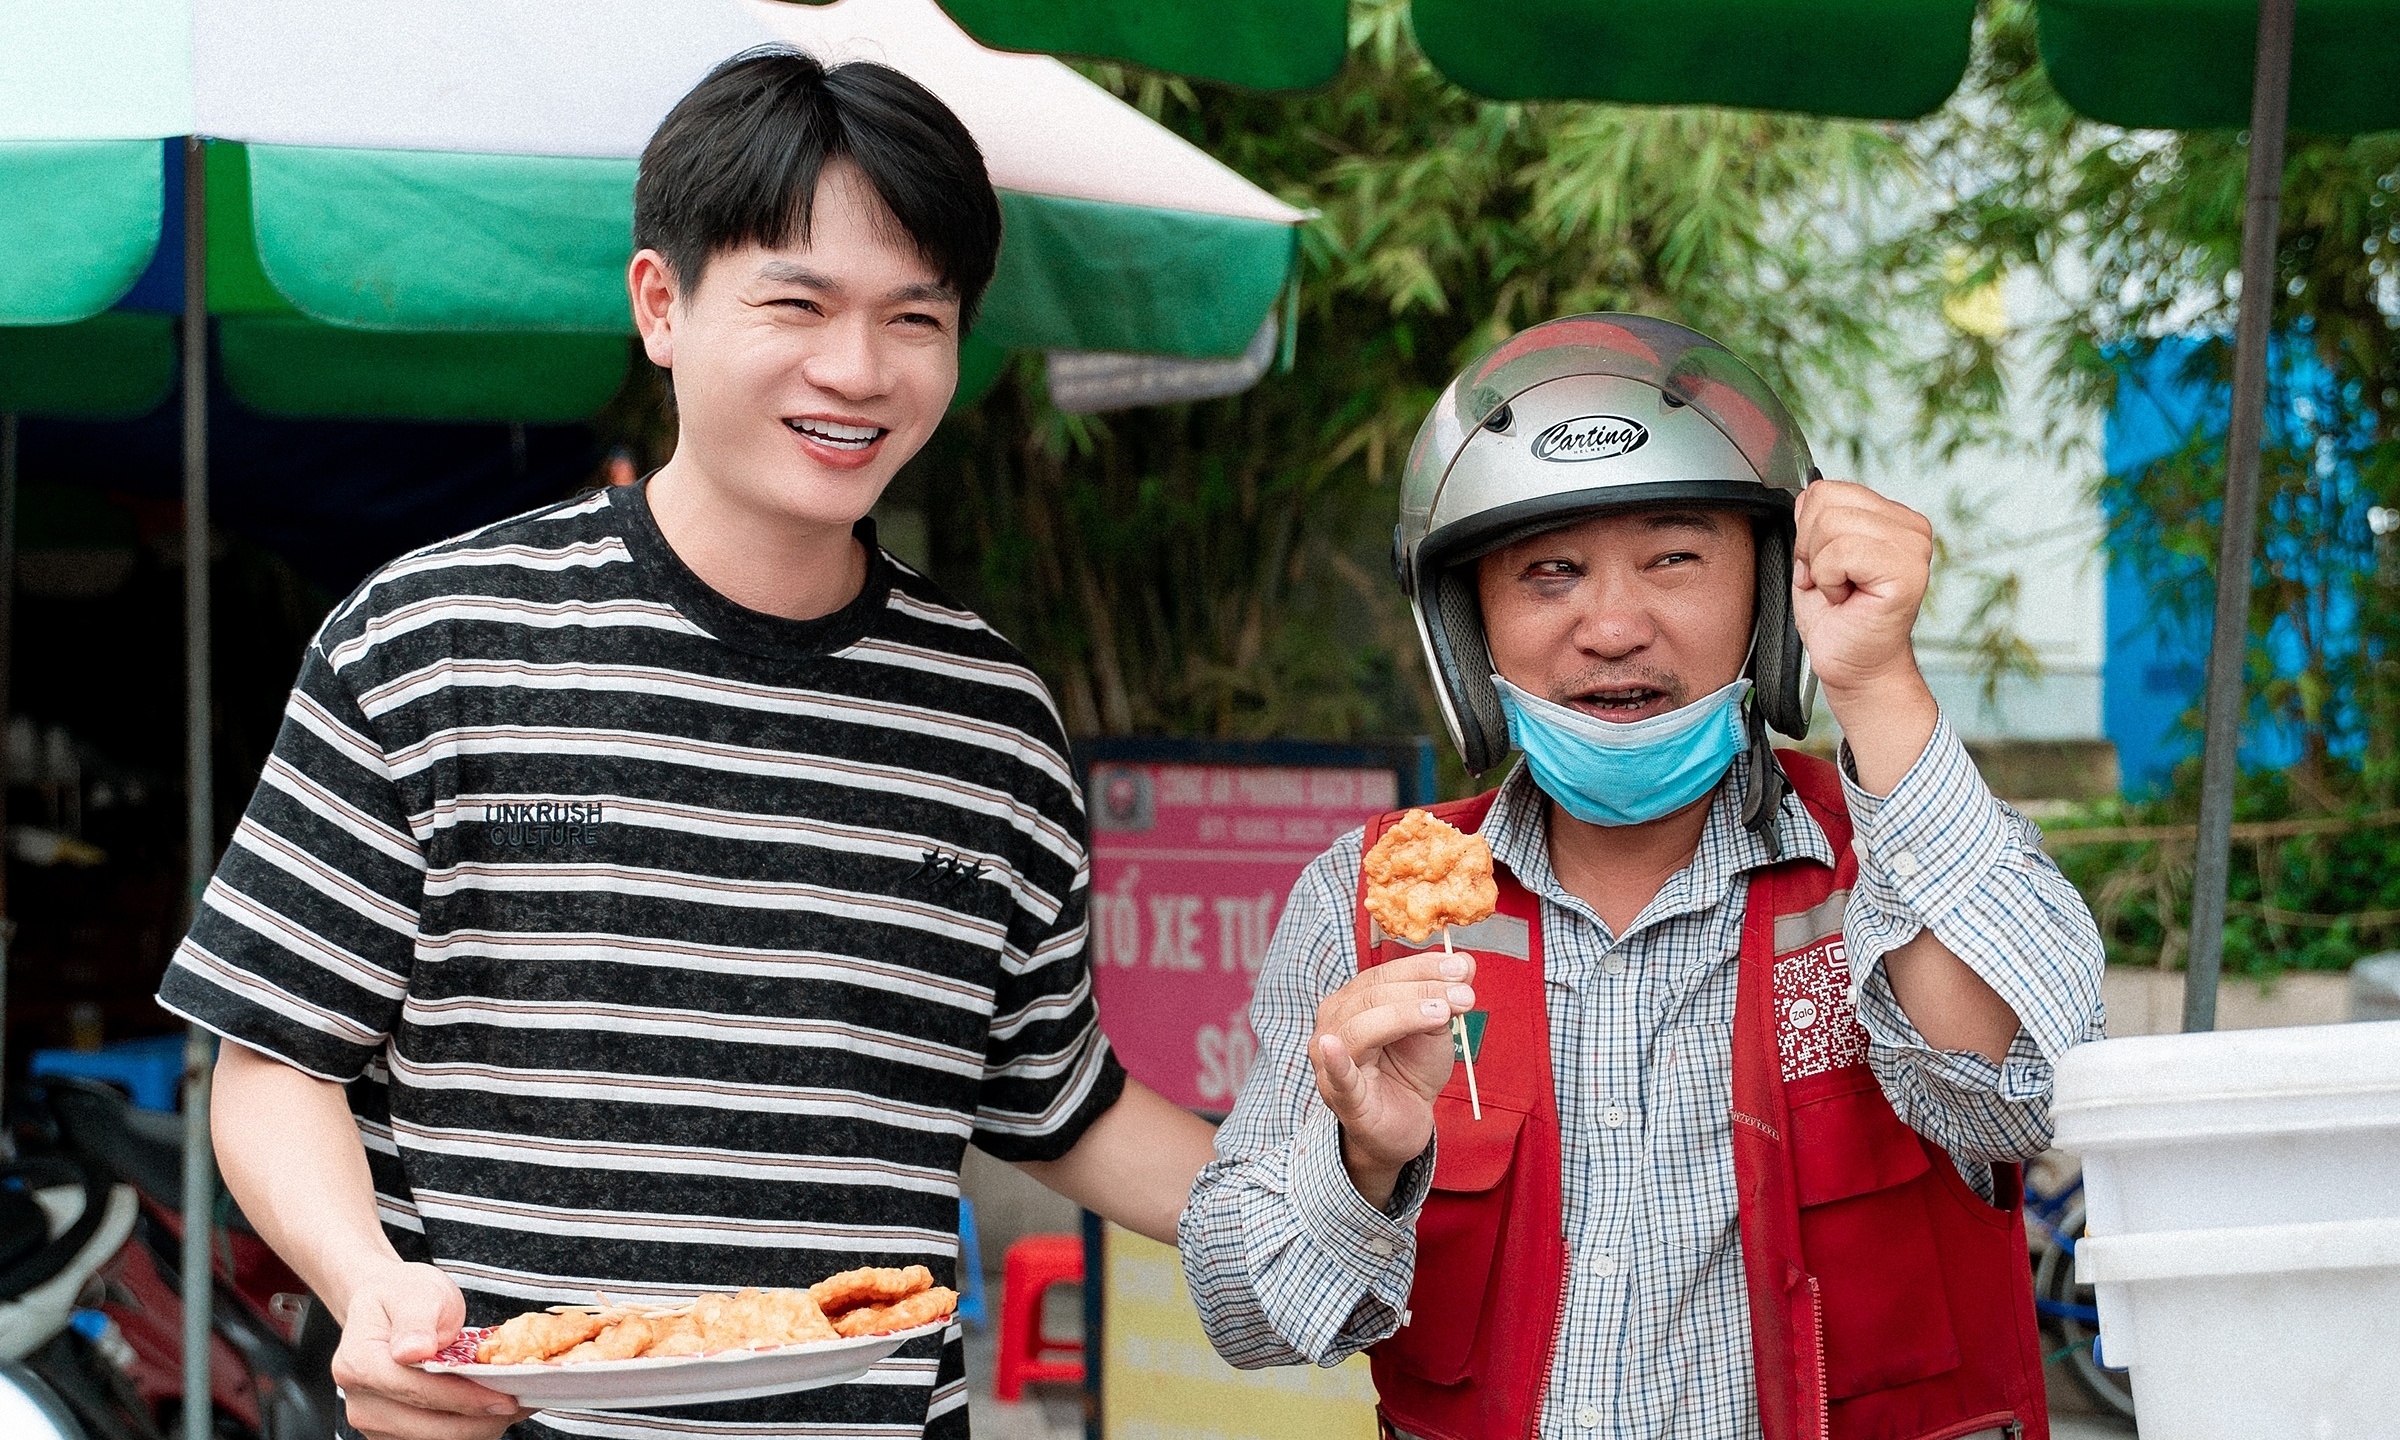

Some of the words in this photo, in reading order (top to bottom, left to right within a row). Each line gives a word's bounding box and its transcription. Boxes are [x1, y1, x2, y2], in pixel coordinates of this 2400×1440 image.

[1538, 423, 1644, 458] Carting
[1573, 446, 1607, 455] HELMET
[485, 802, 602, 825] UNKRUSH
[490, 825, 599, 846] CULTURE
[1149, 894, 1204, 970] XE
[1792, 1008, 1814, 1022] Zalo
